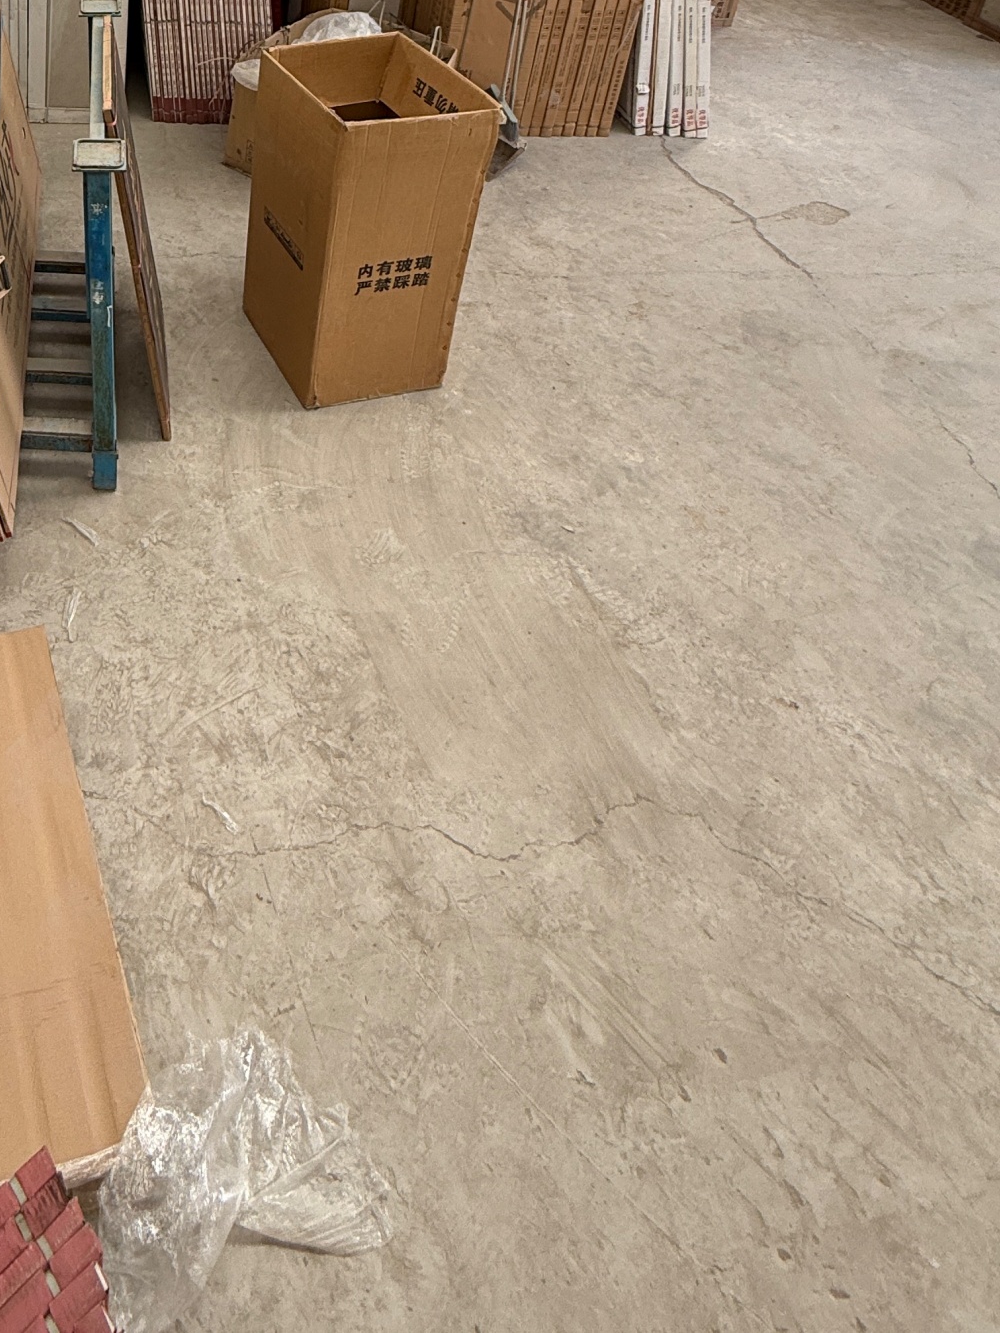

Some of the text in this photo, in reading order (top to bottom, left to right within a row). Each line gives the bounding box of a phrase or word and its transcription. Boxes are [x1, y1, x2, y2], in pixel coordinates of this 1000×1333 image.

[357, 254, 432, 280] 内有玻璃
[354, 272, 430, 295] 严禁踩踏
